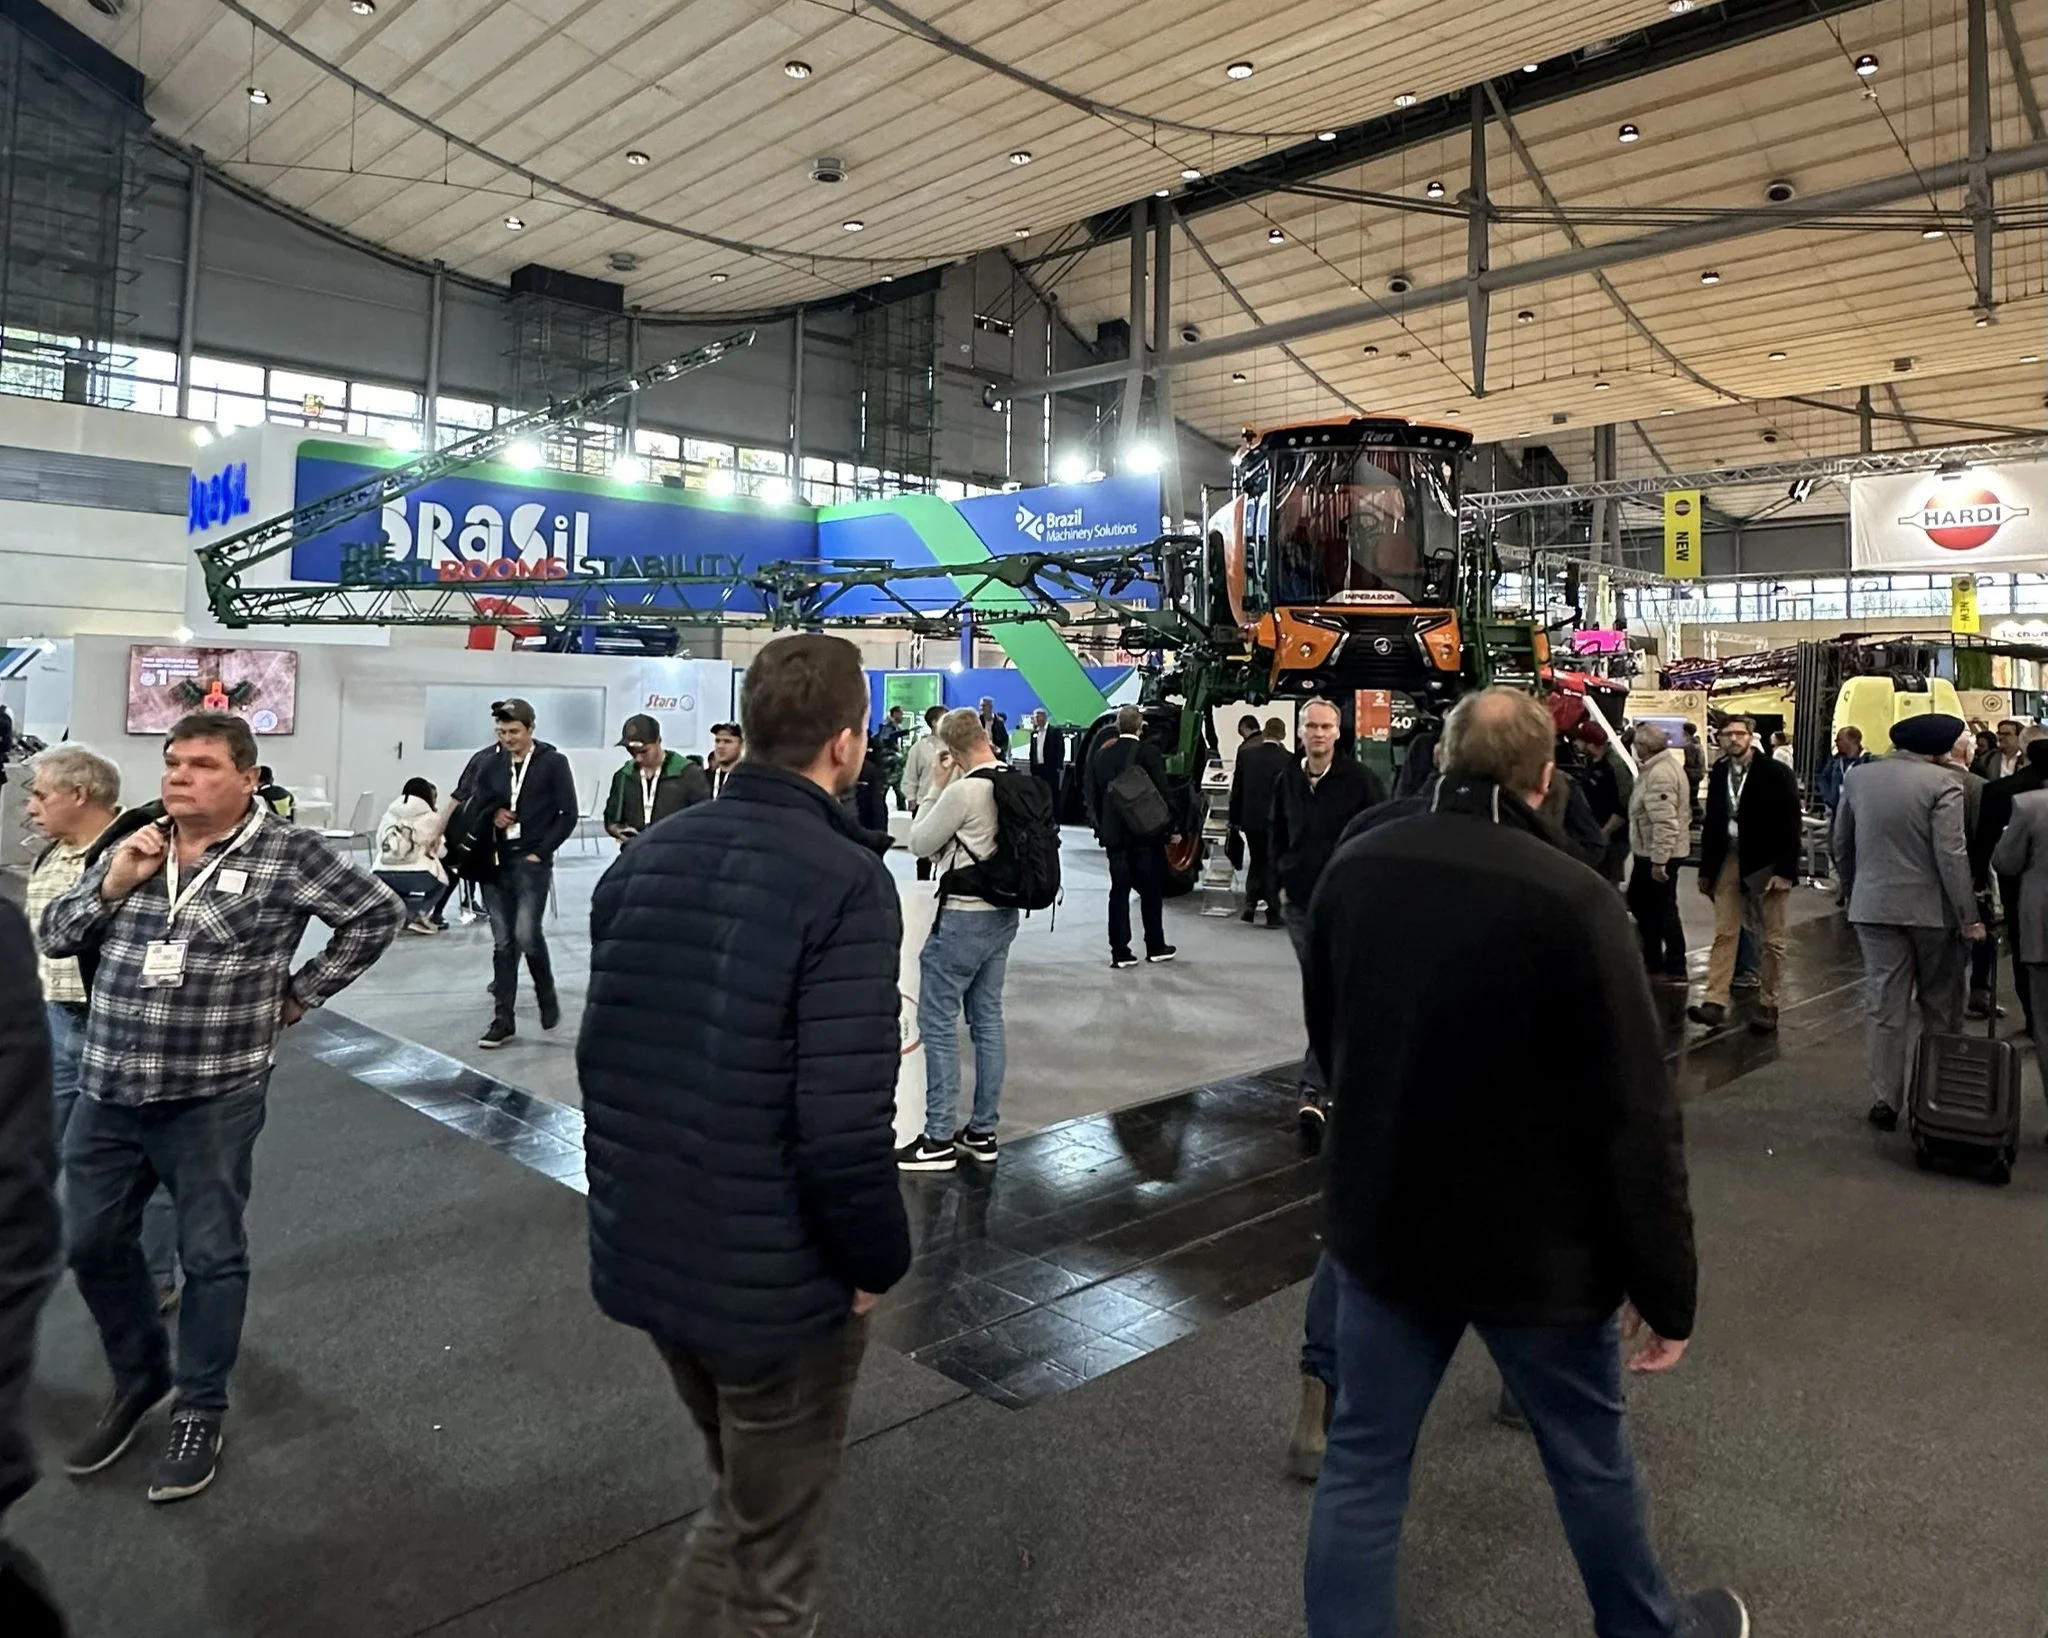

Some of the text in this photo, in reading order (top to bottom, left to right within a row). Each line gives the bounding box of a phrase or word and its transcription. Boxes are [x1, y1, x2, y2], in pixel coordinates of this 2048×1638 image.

[1046, 508, 1083, 528] Brazil
[1924, 507, 2001, 525] HARDI
[1046, 523, 1138, 542] Machinery Solutions
[1676, 531, 1689, 561] NEW
[341, 552, 746, 584] BEST BOOMS STABILITY
[1960, 601, 1970, 621] NEW
[645, 694, 678, 708] Stara
[1375, 692, 1385, 703] 2
